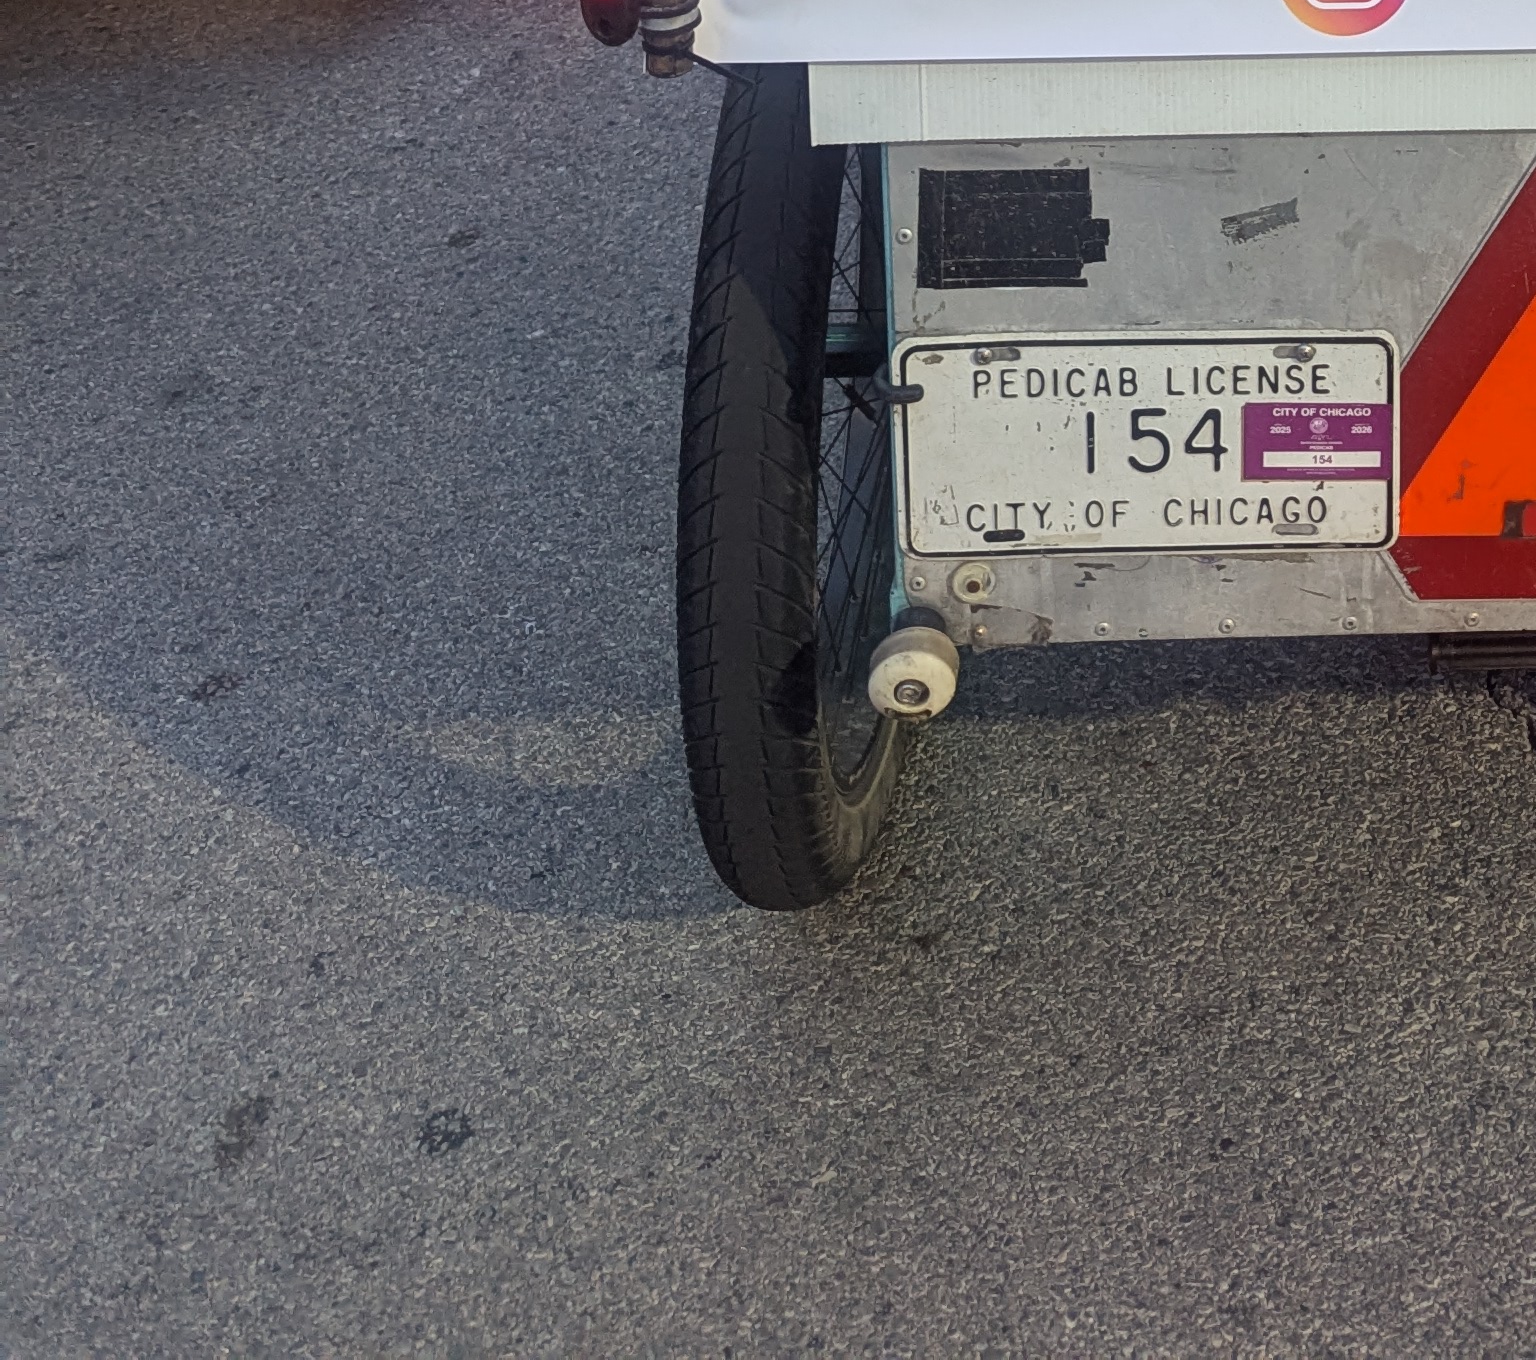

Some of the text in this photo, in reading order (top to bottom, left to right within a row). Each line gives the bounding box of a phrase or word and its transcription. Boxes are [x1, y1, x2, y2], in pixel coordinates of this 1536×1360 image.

[972, 364, 1331, 398] PEDICAB LICENSE
[1272, 407, 1371, 417] CITY OF CHICAGO
[1086, 407, 1229, 474] 154
[1312, 455, 1333, 464] 154
[966, 496, 1328, 533] CITY OF CHICAGO
